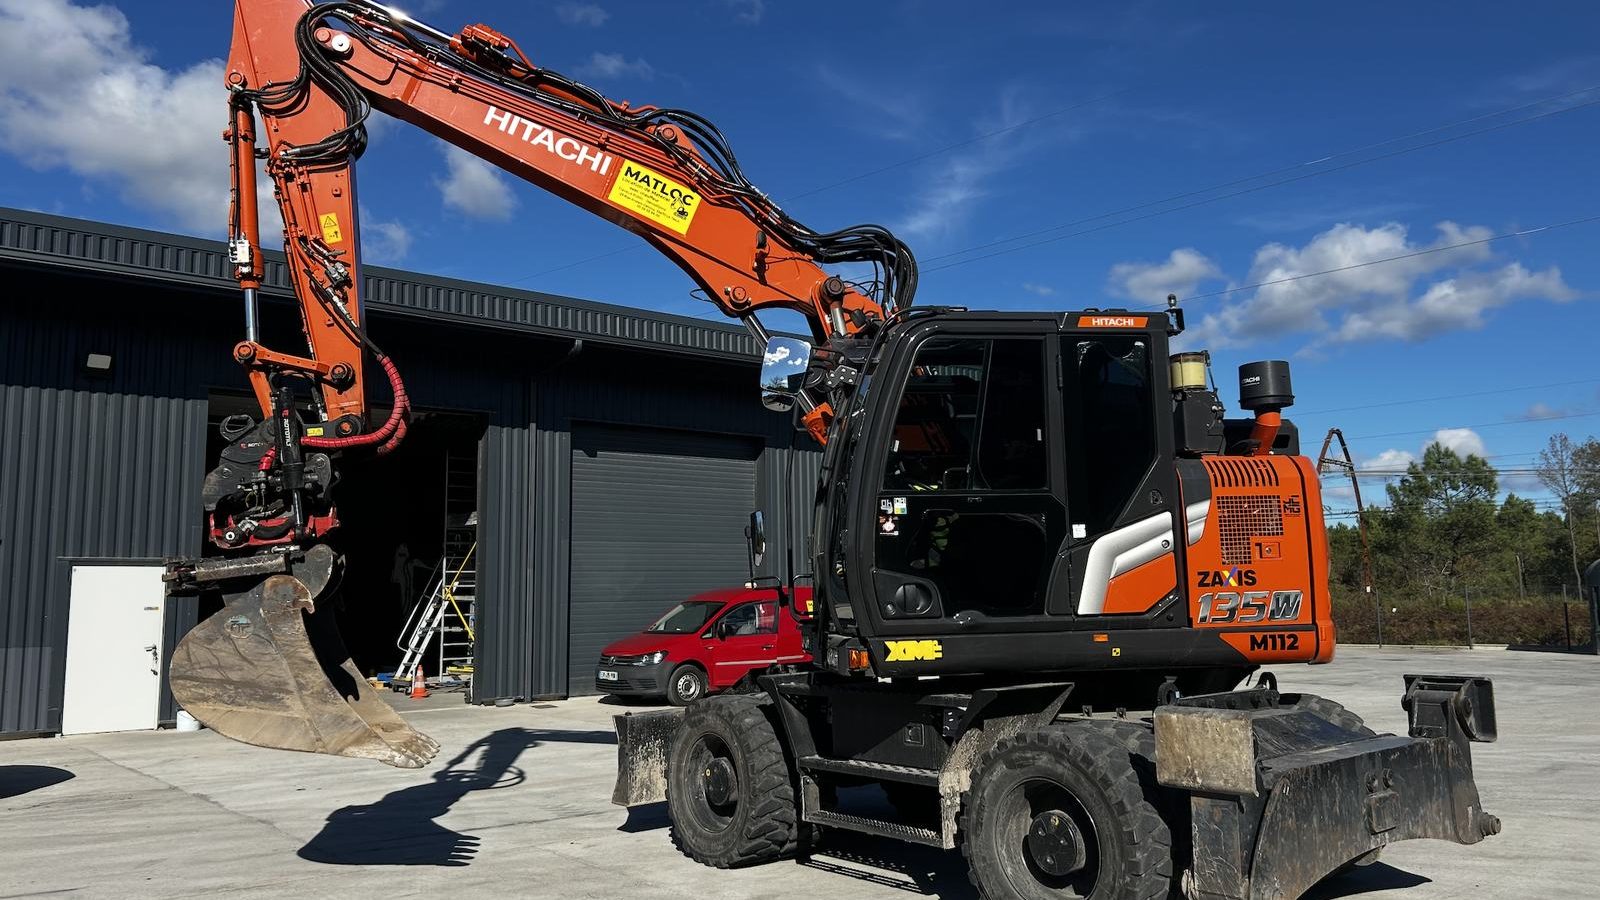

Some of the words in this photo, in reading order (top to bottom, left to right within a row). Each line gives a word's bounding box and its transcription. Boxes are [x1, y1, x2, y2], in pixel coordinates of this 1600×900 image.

[483, 106, 612, 176] HITACHI
[625, 166, 694, 206] MATLOC
[1092, 318, 1134, 326] HITACHI
[1197, 566, 1257, 587] ZAXIS
[1198, 590, 1303, 624] 135W
[1250, 634, 1299, 651] M112
